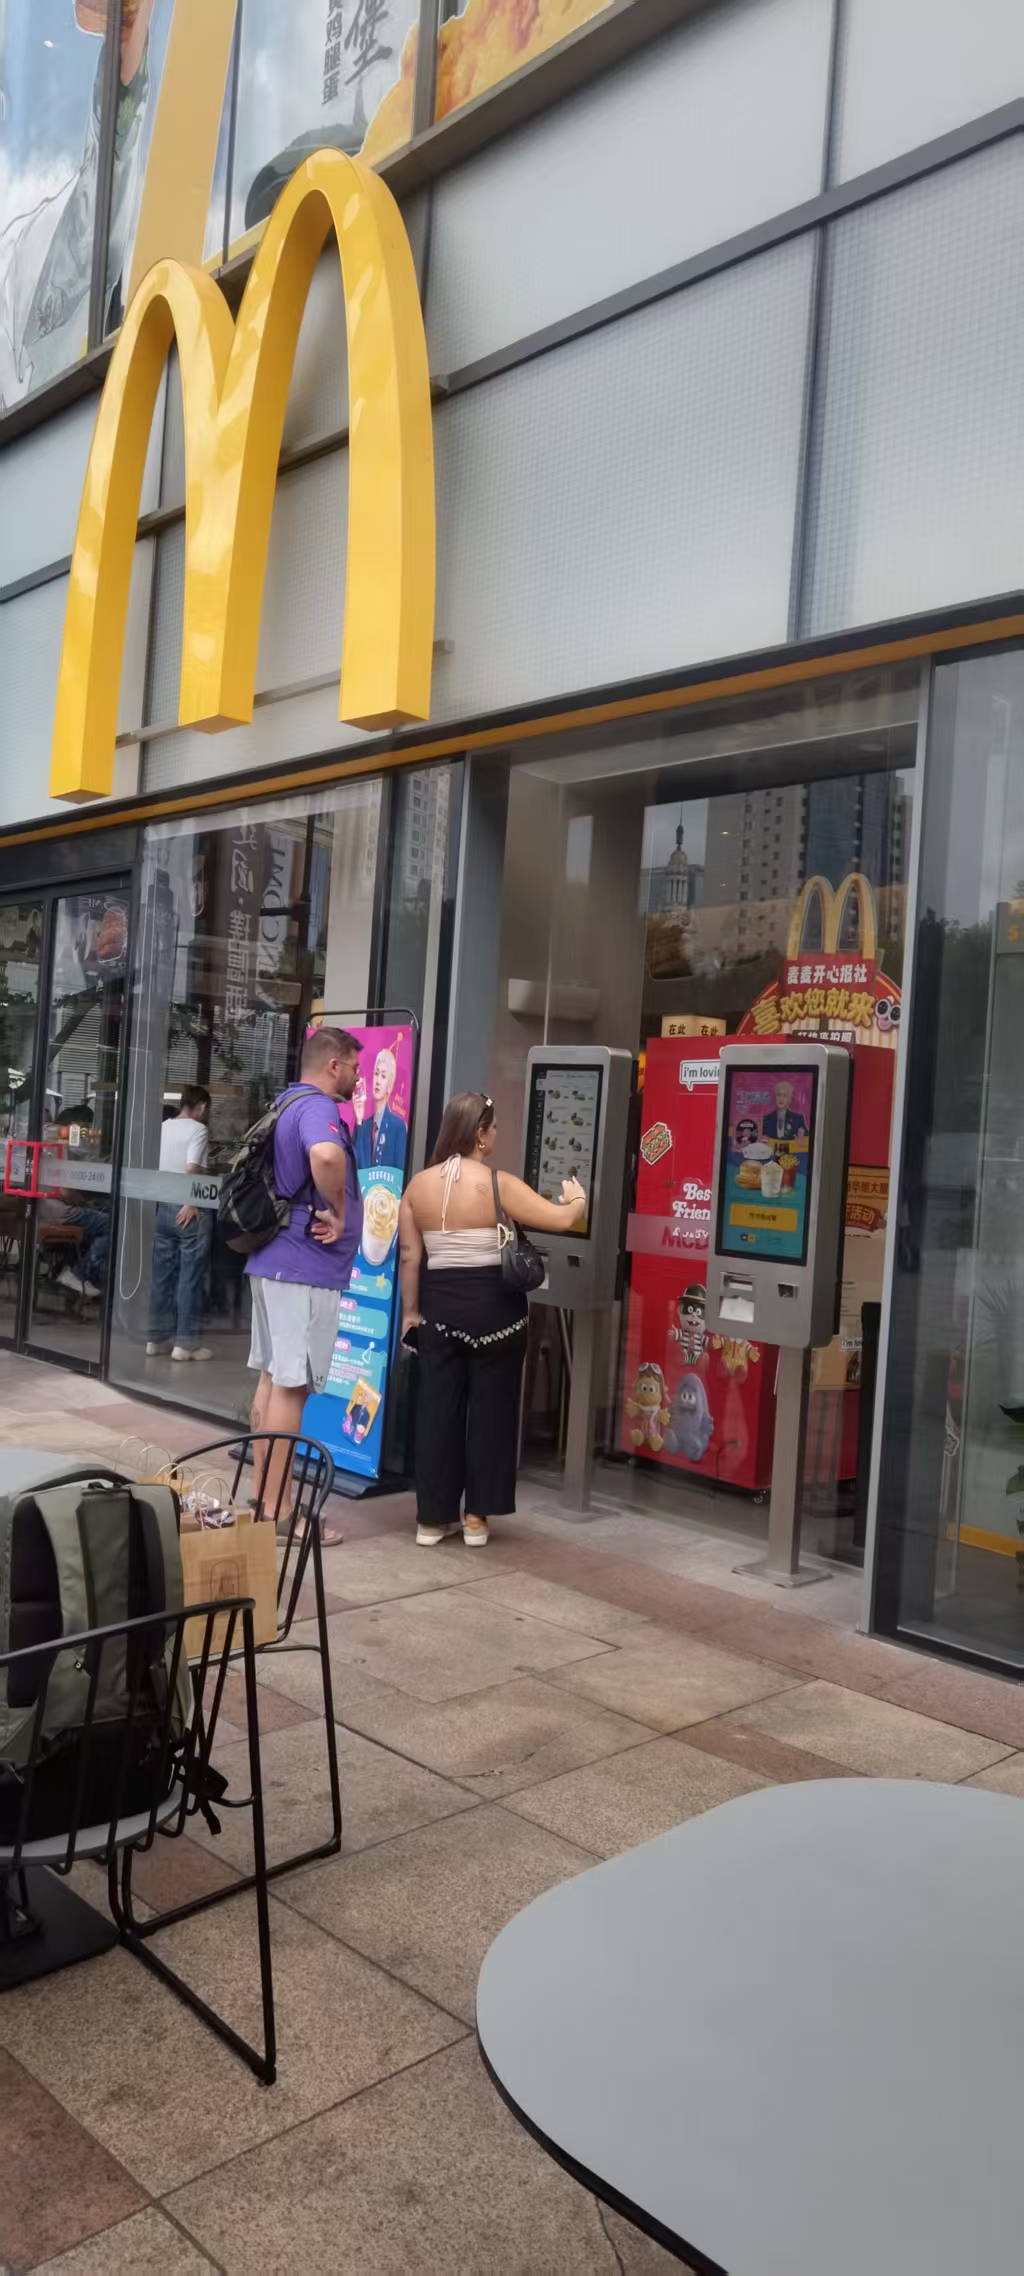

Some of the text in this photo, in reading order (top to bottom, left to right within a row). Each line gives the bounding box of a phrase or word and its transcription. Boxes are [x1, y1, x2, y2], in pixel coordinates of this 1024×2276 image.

[787, 964, 868, 985] 麦麦开心报社
[751, 987, 876, 1034] 喜欢您就来
[669, 1024, 686, 1036] 在此
[683, 1066, 698, 1078] i'm
[683, 1182, 712, 1201] Bes
